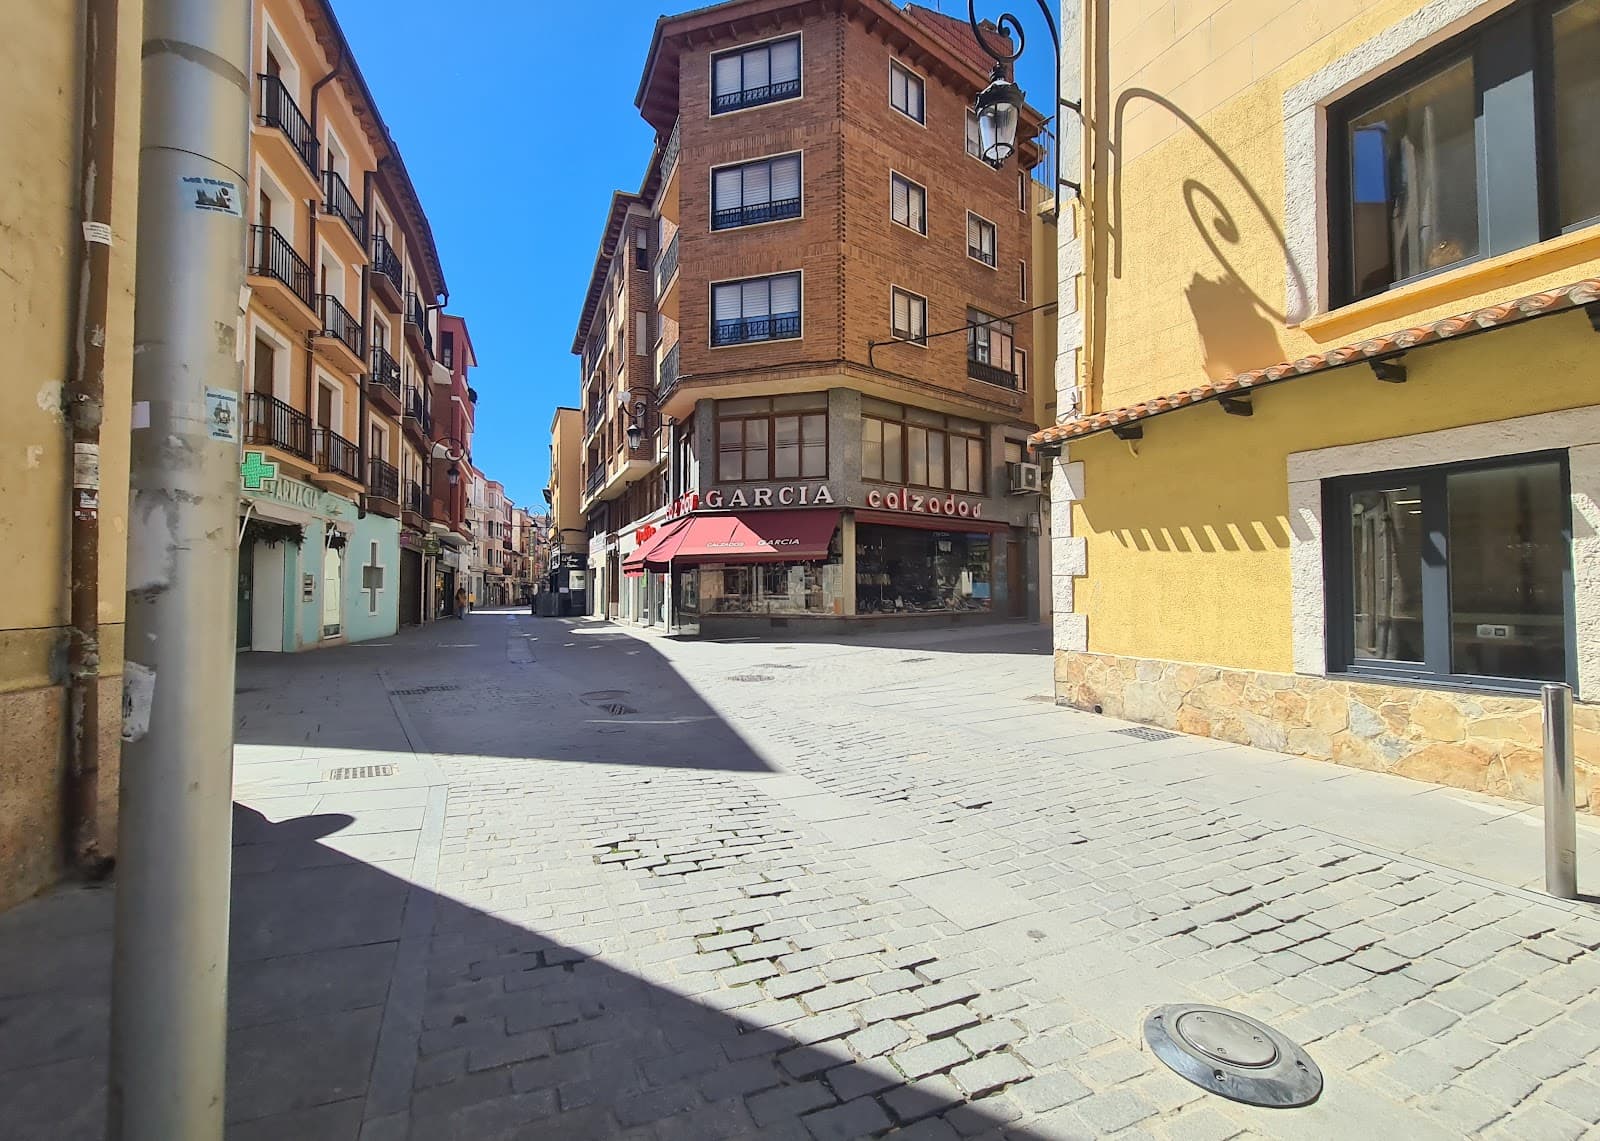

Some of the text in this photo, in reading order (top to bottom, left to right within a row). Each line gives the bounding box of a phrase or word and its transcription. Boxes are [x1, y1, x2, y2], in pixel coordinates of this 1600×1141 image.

[270, 478, 319, 510] FARMACIA
[705, 485, 834, 508] GARCIA
[868, 487, 982, 519] calzados
[757, 538, 800, 546] GARCIA
